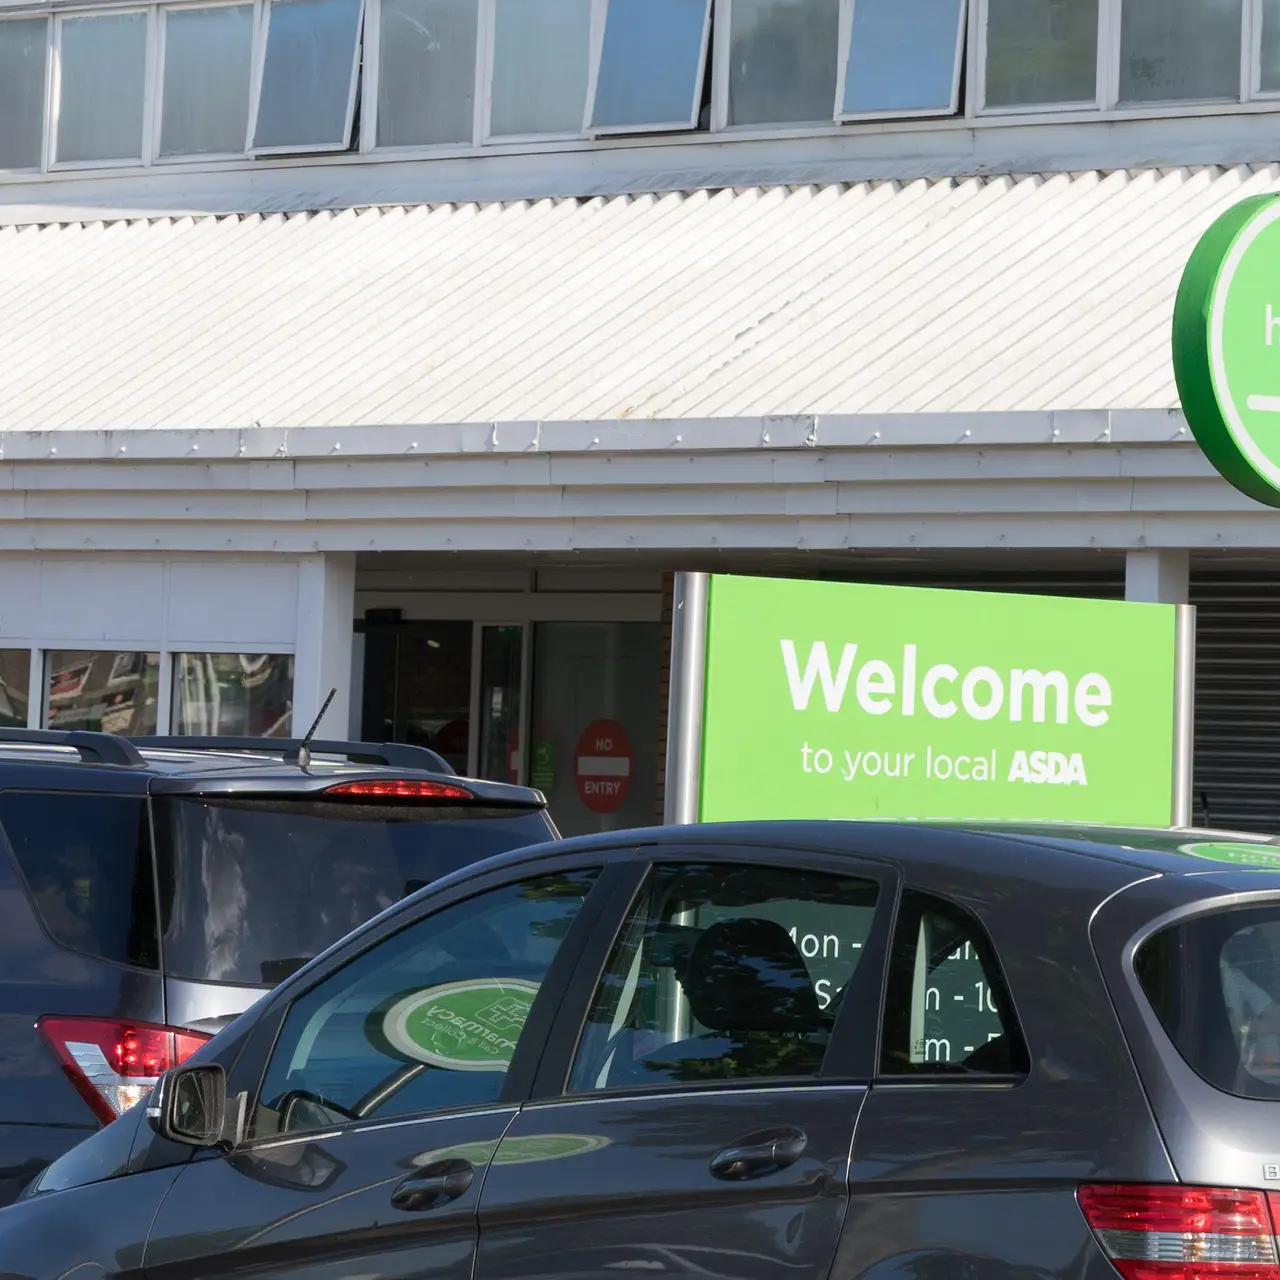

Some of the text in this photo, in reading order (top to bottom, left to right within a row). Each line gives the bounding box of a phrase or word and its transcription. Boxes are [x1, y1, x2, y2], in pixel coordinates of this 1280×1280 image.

[780, 639, 1113, 727] Welcome
[596, 739, 612, 751] NO
[801, 741, 1088, 786] to your local ASDA
[584, 781, 621, 795] ENTRY
